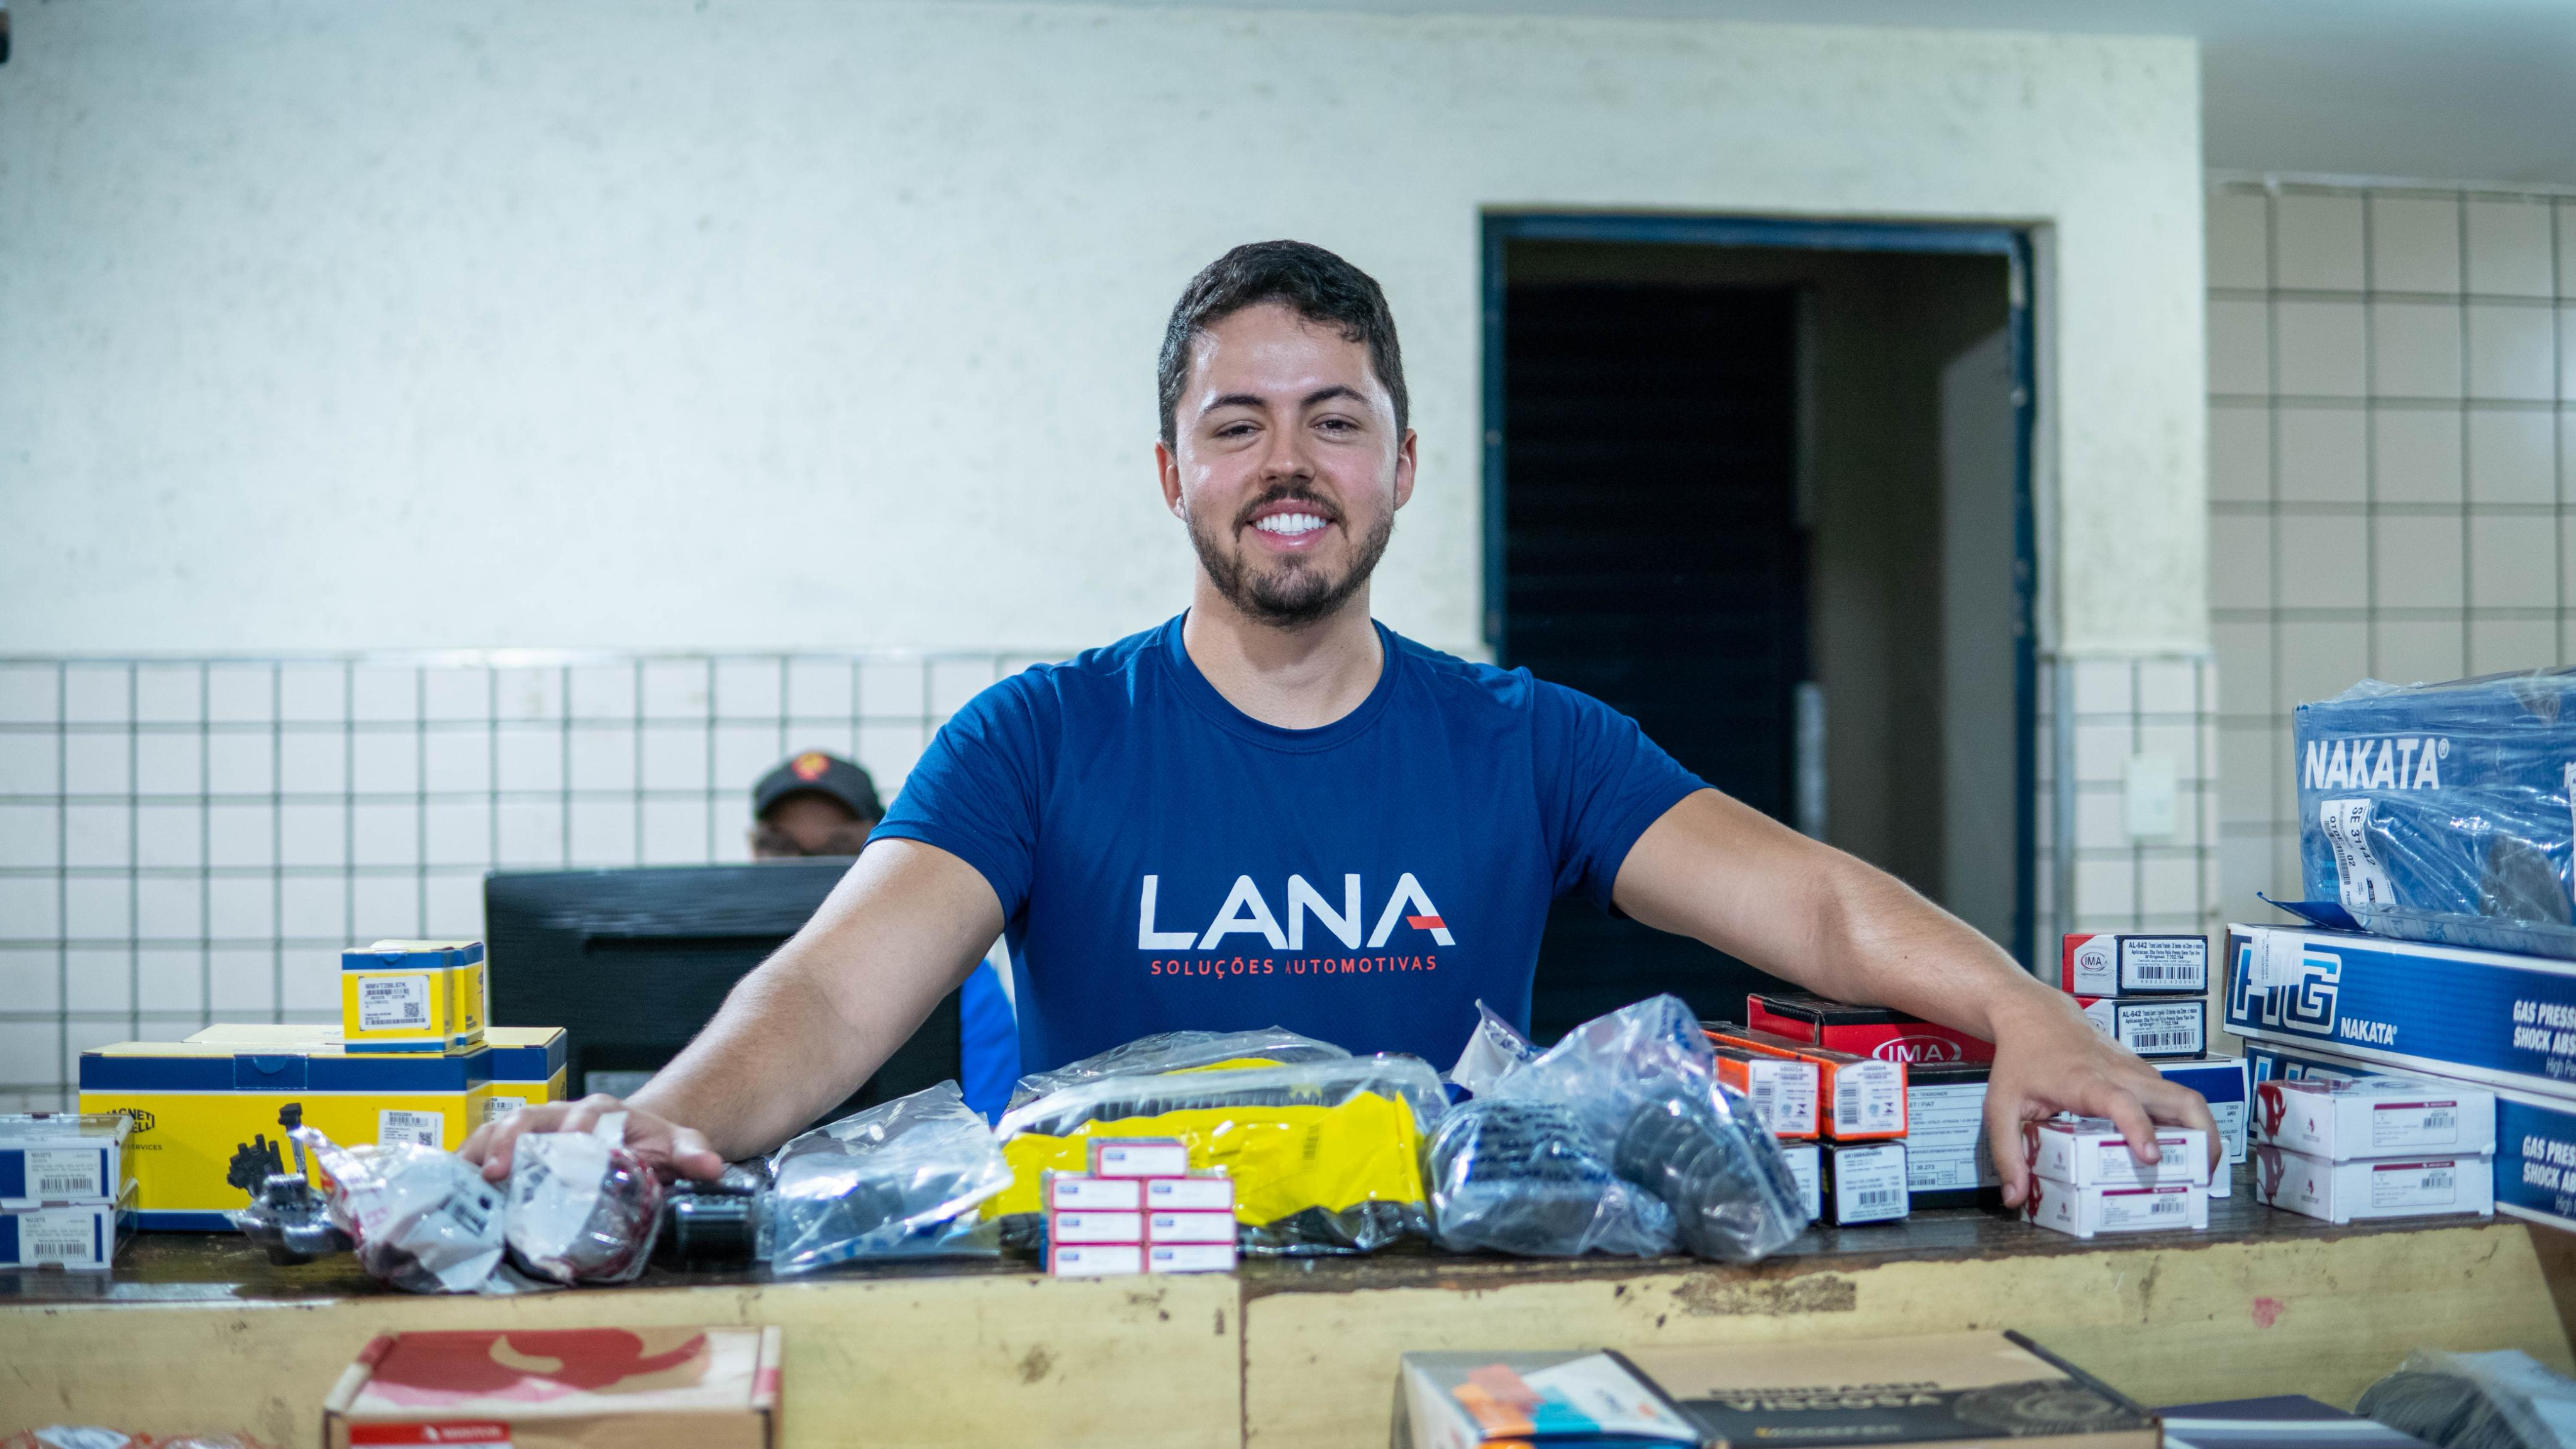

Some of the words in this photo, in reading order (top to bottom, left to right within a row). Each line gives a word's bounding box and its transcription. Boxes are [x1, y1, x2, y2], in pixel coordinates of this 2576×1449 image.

[2350, 807, 2363, 823] SE
[2347, 855, 2355, 867] 02
[1138, 872, 1456, 950] LANA
[1151, 957, 1274, 979] SOLUÇÕES
[1285, 955, 1436, 975] AUTOMOTIVAS
[2085, 957, 2102, 965] IMA
[2513, 1000, 2537, 1023] GAS
[2538, 1003, 2576, 1029] PRESS
[2513, 1025, 2551, 1052] SHOCK
[2552, 1031, 2576, 1055] ABS
[1889, 1045, 1944, 1062] IMA
[2522, 1135, 2545, 1159] GAS
[2546, 1141, 2576, 1167] PRES
[2523, 1162, 2560, 1189] SHOCK
